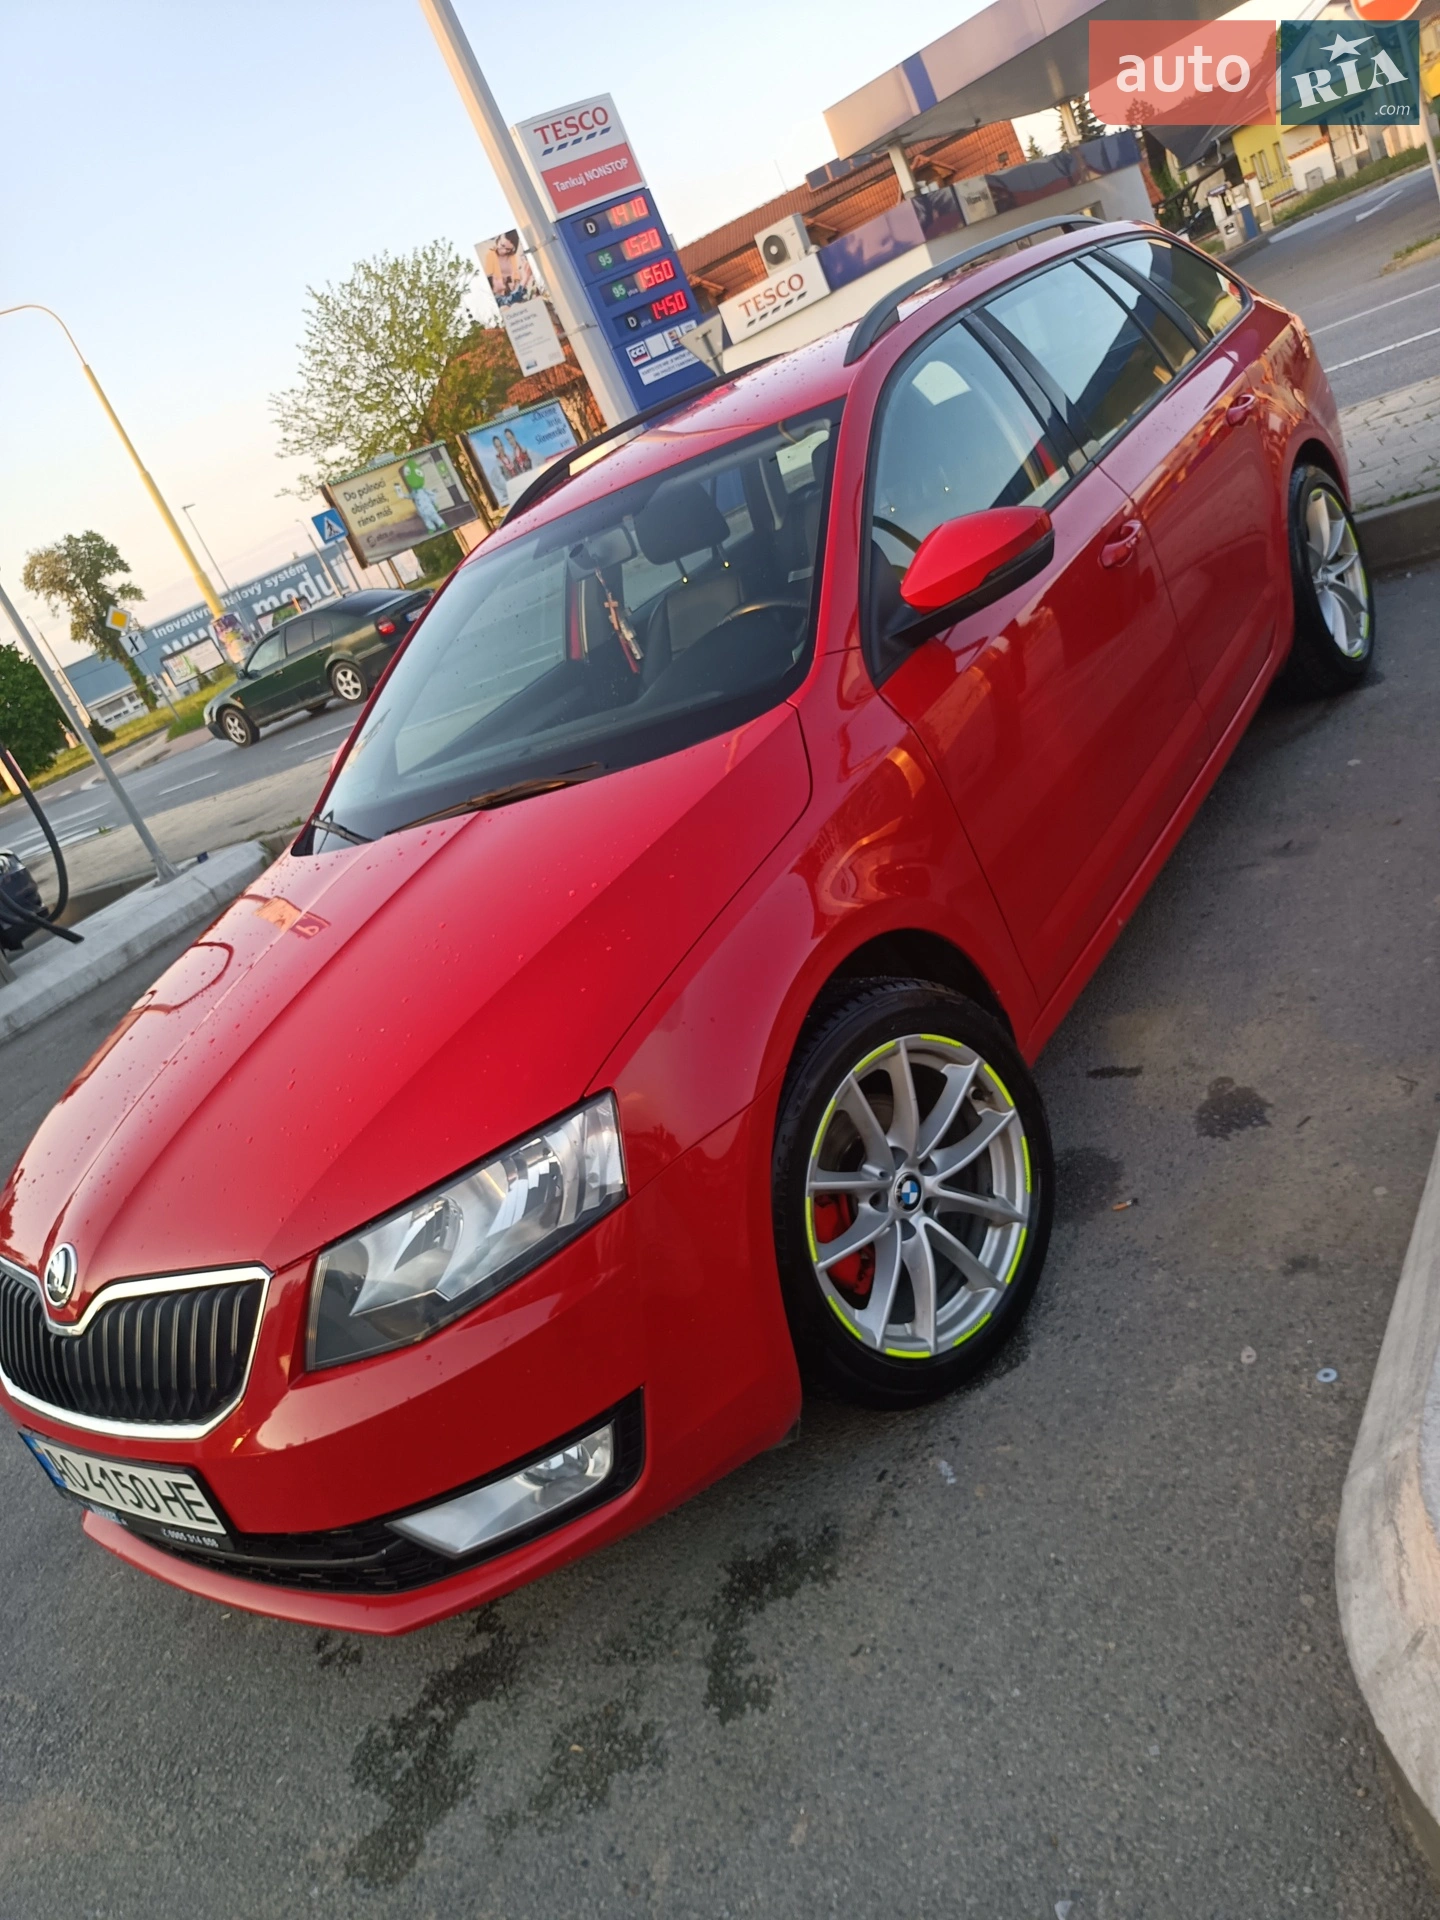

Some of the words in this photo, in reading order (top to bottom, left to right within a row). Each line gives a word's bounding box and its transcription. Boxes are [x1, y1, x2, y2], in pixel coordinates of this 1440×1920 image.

[533, 106, 609, 145] TESCO
[553, 174, 587, 192] Tankuj
[584, 158, 628, 182] NONSTOP
[586, 222, 596, 234] D
[598, 253, 612, 267] 95
[612, 284, 626, 298] 95
[738, 273, 804, 318] TESCO
[627, 316, 637, 328] D
[343, 490, 357, 502] Do
[152, 606, 212, 640] Inovatívn
[264, 562, 308, 588] systém
